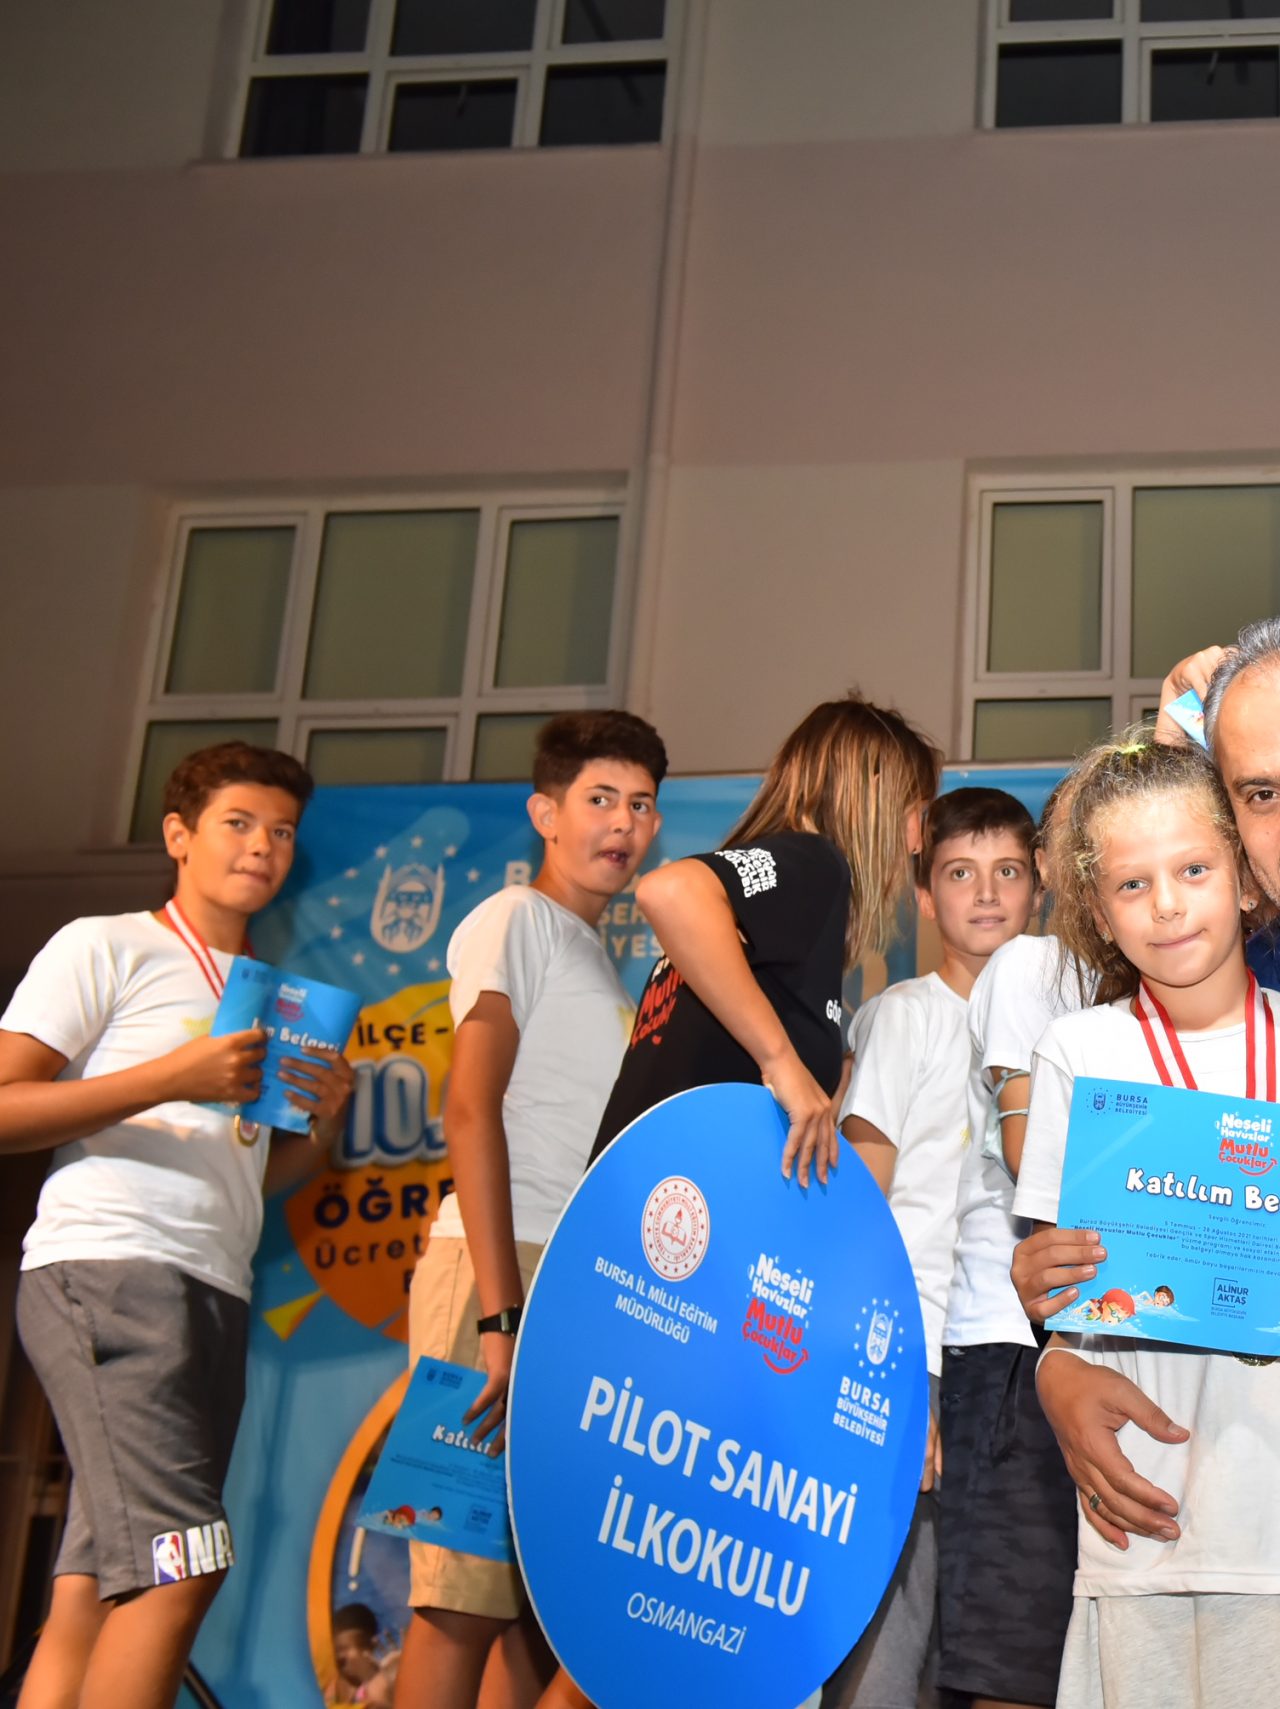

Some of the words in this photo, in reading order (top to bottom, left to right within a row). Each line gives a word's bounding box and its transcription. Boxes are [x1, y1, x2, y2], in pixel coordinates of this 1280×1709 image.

[1117, 1093, 1149, 1104] BURSA
[1221, 1126, 1270, 1143] Havuzlar
[1222, 1112, 1272, 1133] Neşeli
[1218, 1152, 1268, 1168] Çocuklar
[1220, 1138, 1269, 1158] Mutlu
[1126, 1167, 1234, 1207] Katılım
[594, 1256, 635, 1291] BURSA
[635, 1275, 646, 1297] İL
[647, 1284, 680, 1314] MİLLİ
[678, 1303, 718, 1334] EĞİTİM
[751, 1276, 808, 1319] Havuzlar
[755, 1253, 815, 1305] Neşeli
[1217, 1284, 1249, 1296] ALİNUR
[614, 1293, 690, 1344] MÜDÜRLÜĞÜ
[1217, 1294, 1247, 1306] AKTAŞ
[745, 1297, 803, 1345] Mutlu
[741, 1320, 798, 1364] Çocuklar
[836, 1396, 889, 1432] BÜYÜKŞEHİR
[839, 1375, 891, 1418] BURSA
[832, 1411, 887, 1448] BELEDİYESİ
[579, 1375, 711, 1478] PİLOT
[708, 1438, 859, 1545] SANAYİ
[597, 1474, 811, 1617] İLKOKULU
[626, 1592, 748, 1656] OSMANGAZİ
